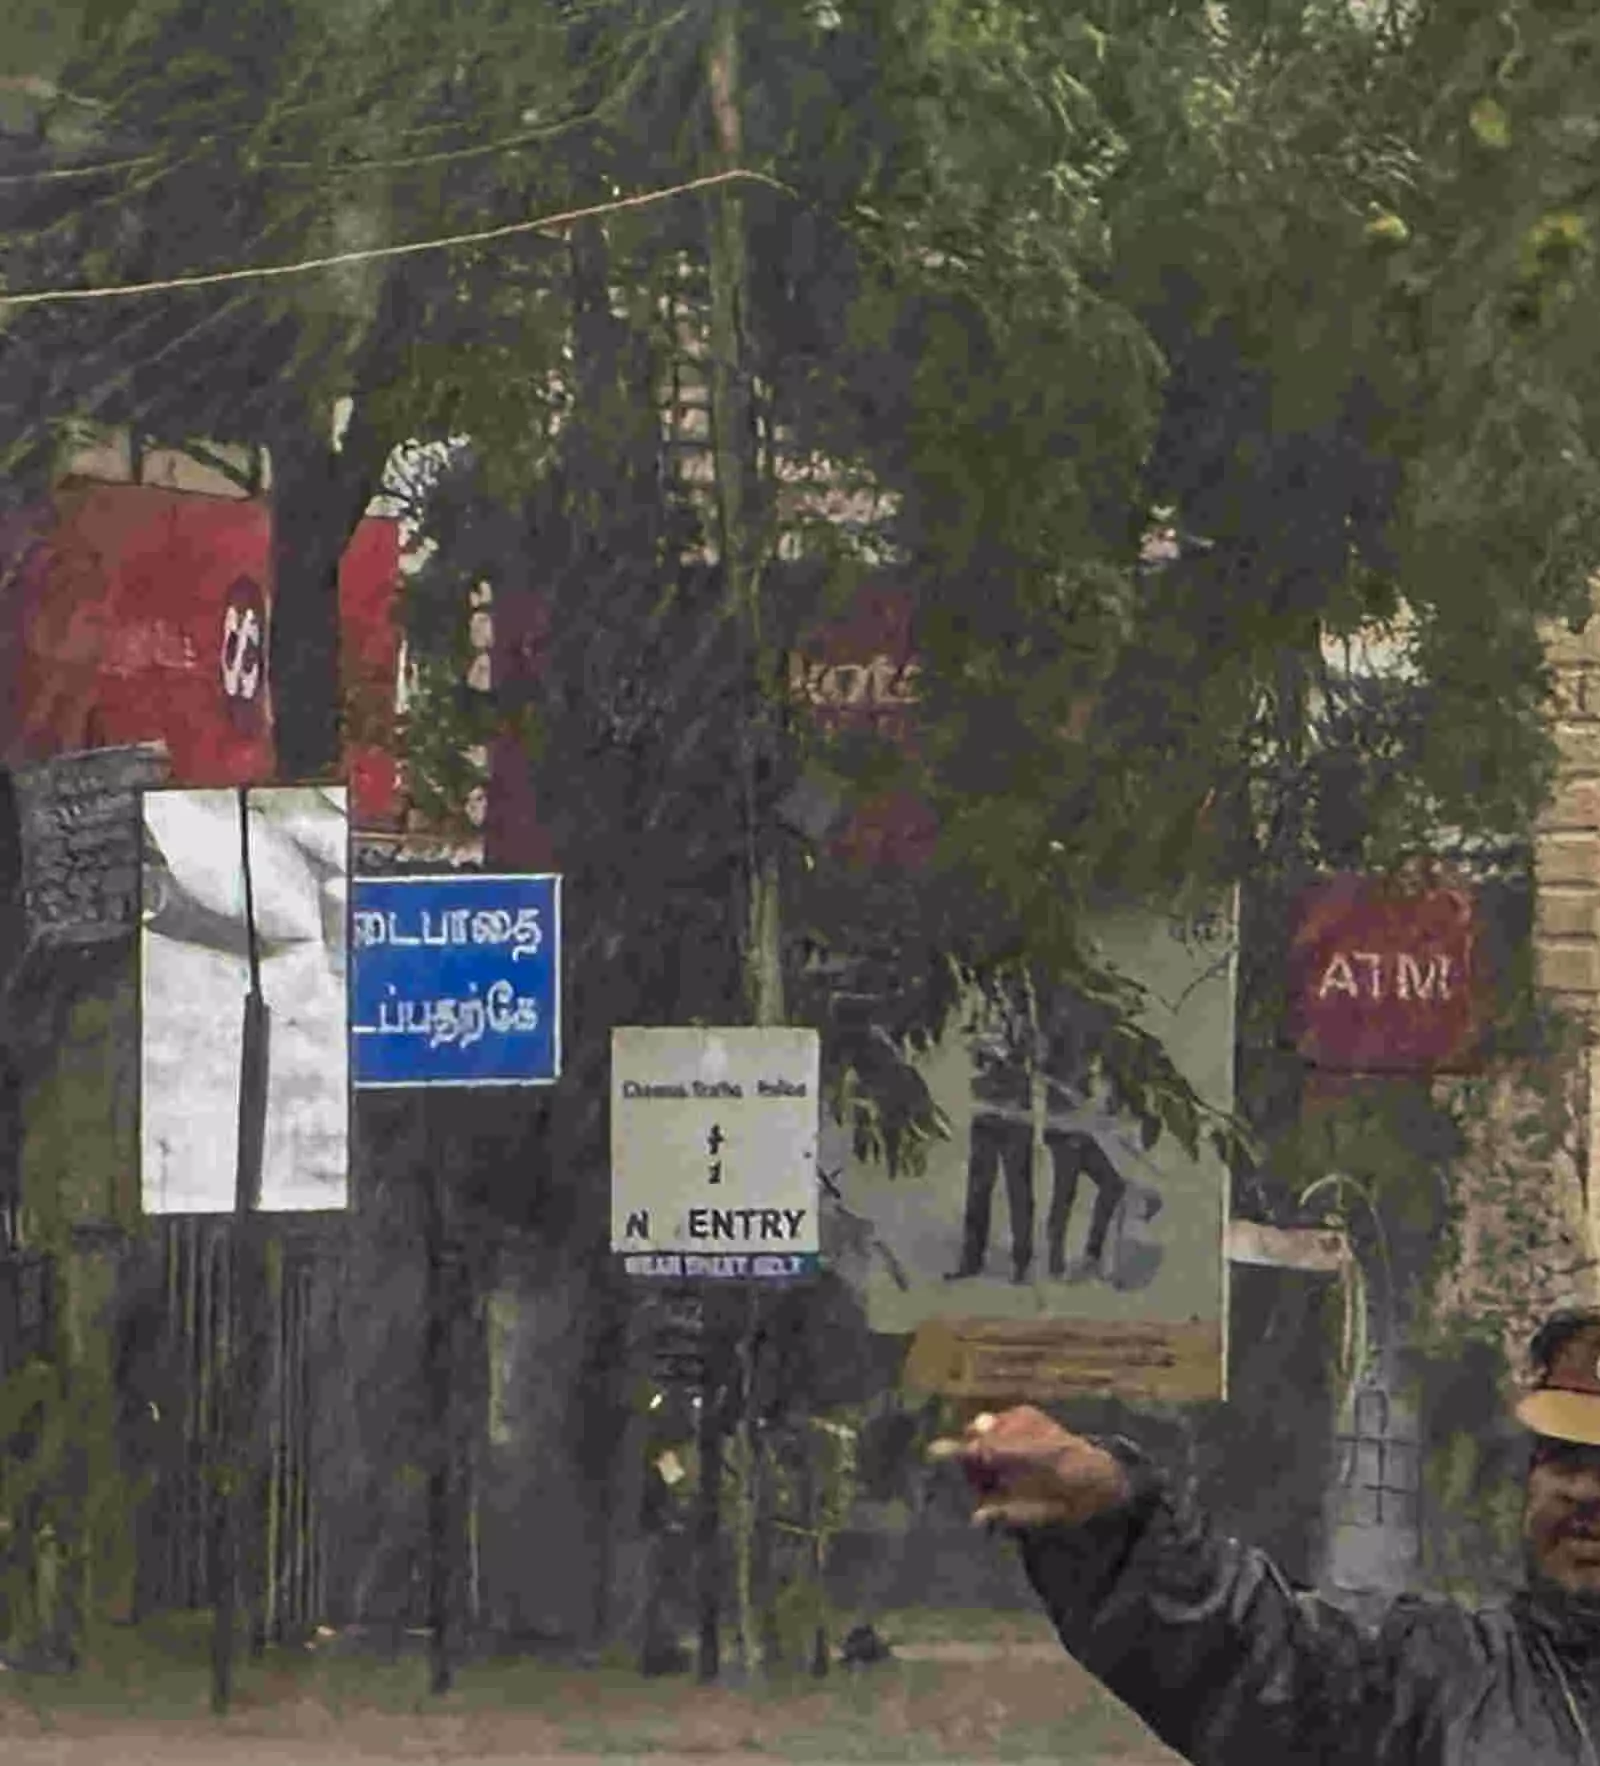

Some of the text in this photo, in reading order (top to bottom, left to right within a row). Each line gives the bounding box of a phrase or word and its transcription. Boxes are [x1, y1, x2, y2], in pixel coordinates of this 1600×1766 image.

[353, 908, 543, 962] டைபாதை
[1319, 951, 1451, 1000] ATM
[688, 1208, 805, 1241] ENTRY
